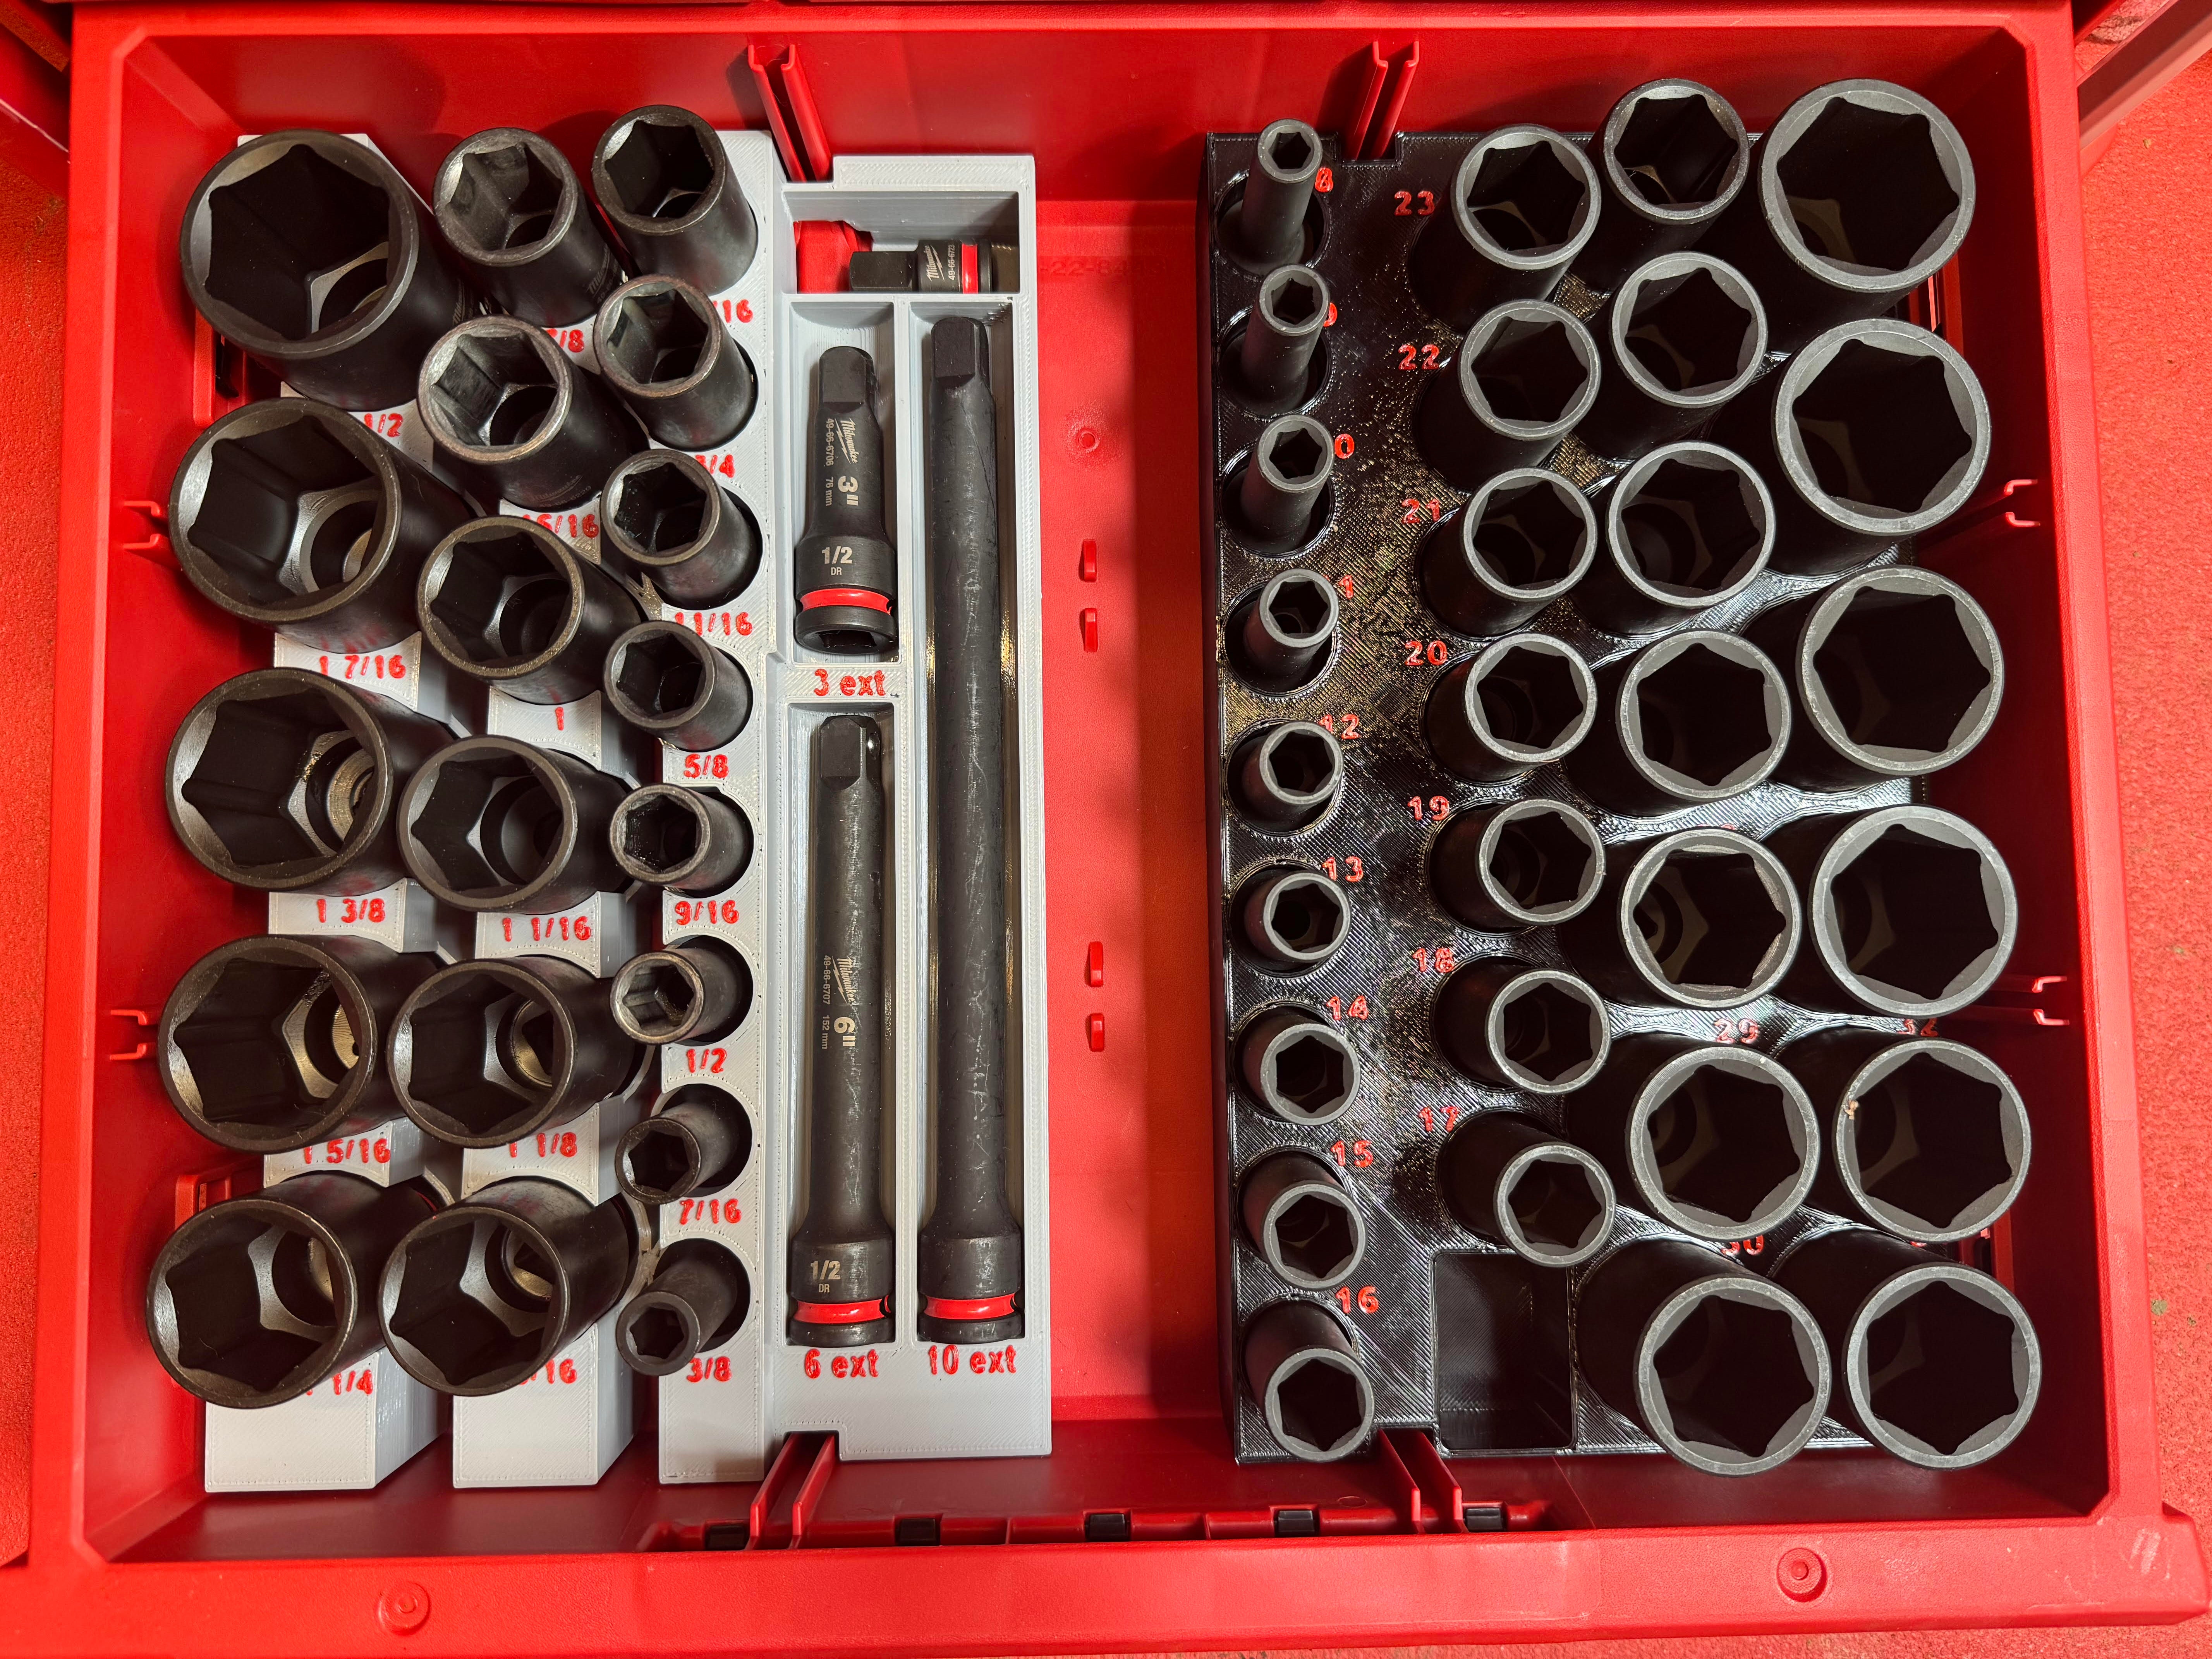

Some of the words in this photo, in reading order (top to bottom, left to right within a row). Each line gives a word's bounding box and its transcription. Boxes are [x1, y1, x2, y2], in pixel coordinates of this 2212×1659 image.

[1315, 167, 1333, 192] 8
[1395, 191, 1435, 215] 23
[1398, 344, 1439, 370] 22
[364, 413, 403, 437] 1/2
[826, 418, 835, 466] 49-66-6706
[840, 417, 859, 464] Milwaukee
[826, 477, 834, 488] 76
[838, 476, 859, 507] 3"
[825, 490, 831, 507] mm
[1402, 499, 1440, 524] 21
[523, 514, 599, 538] 5/16
[821, 546, 852, 564] 1/2
[831, 567, 842, 575] DR
[1324, 575, 1354, 599] 1
[1405, 641, 1448, 666] 20
[319, 656, 328, 676] 1
[345, 654, 406, 679] 7/16
[814, 669, 830, 696] 3
[840, 670, 886, 696] ext
[555, 707, 564, 731] 1
[1318, 714, 1360, 739] 12
[684, 753, 729, 778] 5/8
[1408, 796, 1449, 821] 19
[1322, 856, 1363, 882] 13
[317, 899, 326, 923] 1
[342, 898, 385, 923] 3/8
[675, 900, 739, 926] 9/16
[503, 918, 512, 942] 1
[531, 916, 591, 941] 1/16
[1413, 948, 1455, 973] 18
[823, 955, 831, 1005] 49-66-6707
[836, 956, 857, 1003] Milwaukee
[1326, 996, 1369, 1020] 14
[822, 1015, 830, 1031] 152
[834, 1017, 855, 1046] 6"
[1714, 1018, 1759, 1044] 29
[822, 1033, 828, 1049] mm
[687, 1048, 727, 1073] 1/2
[1418, 1106, 1459, 1132] 17
[327, 1139, 390, 1164] 5/16
[537, 1132, 577, 1158] 1/8
[1331, 1140, 1373, 1168] 15
[680, 1199, 742, 1225] 7/16
[810, 1260, 841, 1280] 1/2
[818, 1283, 830, 1293] DR
[1335, 1286, 1379, 1314] 16
[687, 1357, 732, 1383] 3/8
[805, 1349, 821, 1379] 6
[832, 1350, 879, 1379] ext
[928, 1345, 959, 1375] 10
[970, 1345, 1016, 1374] ext
[333, 1370, 373, 1395] 1/4
